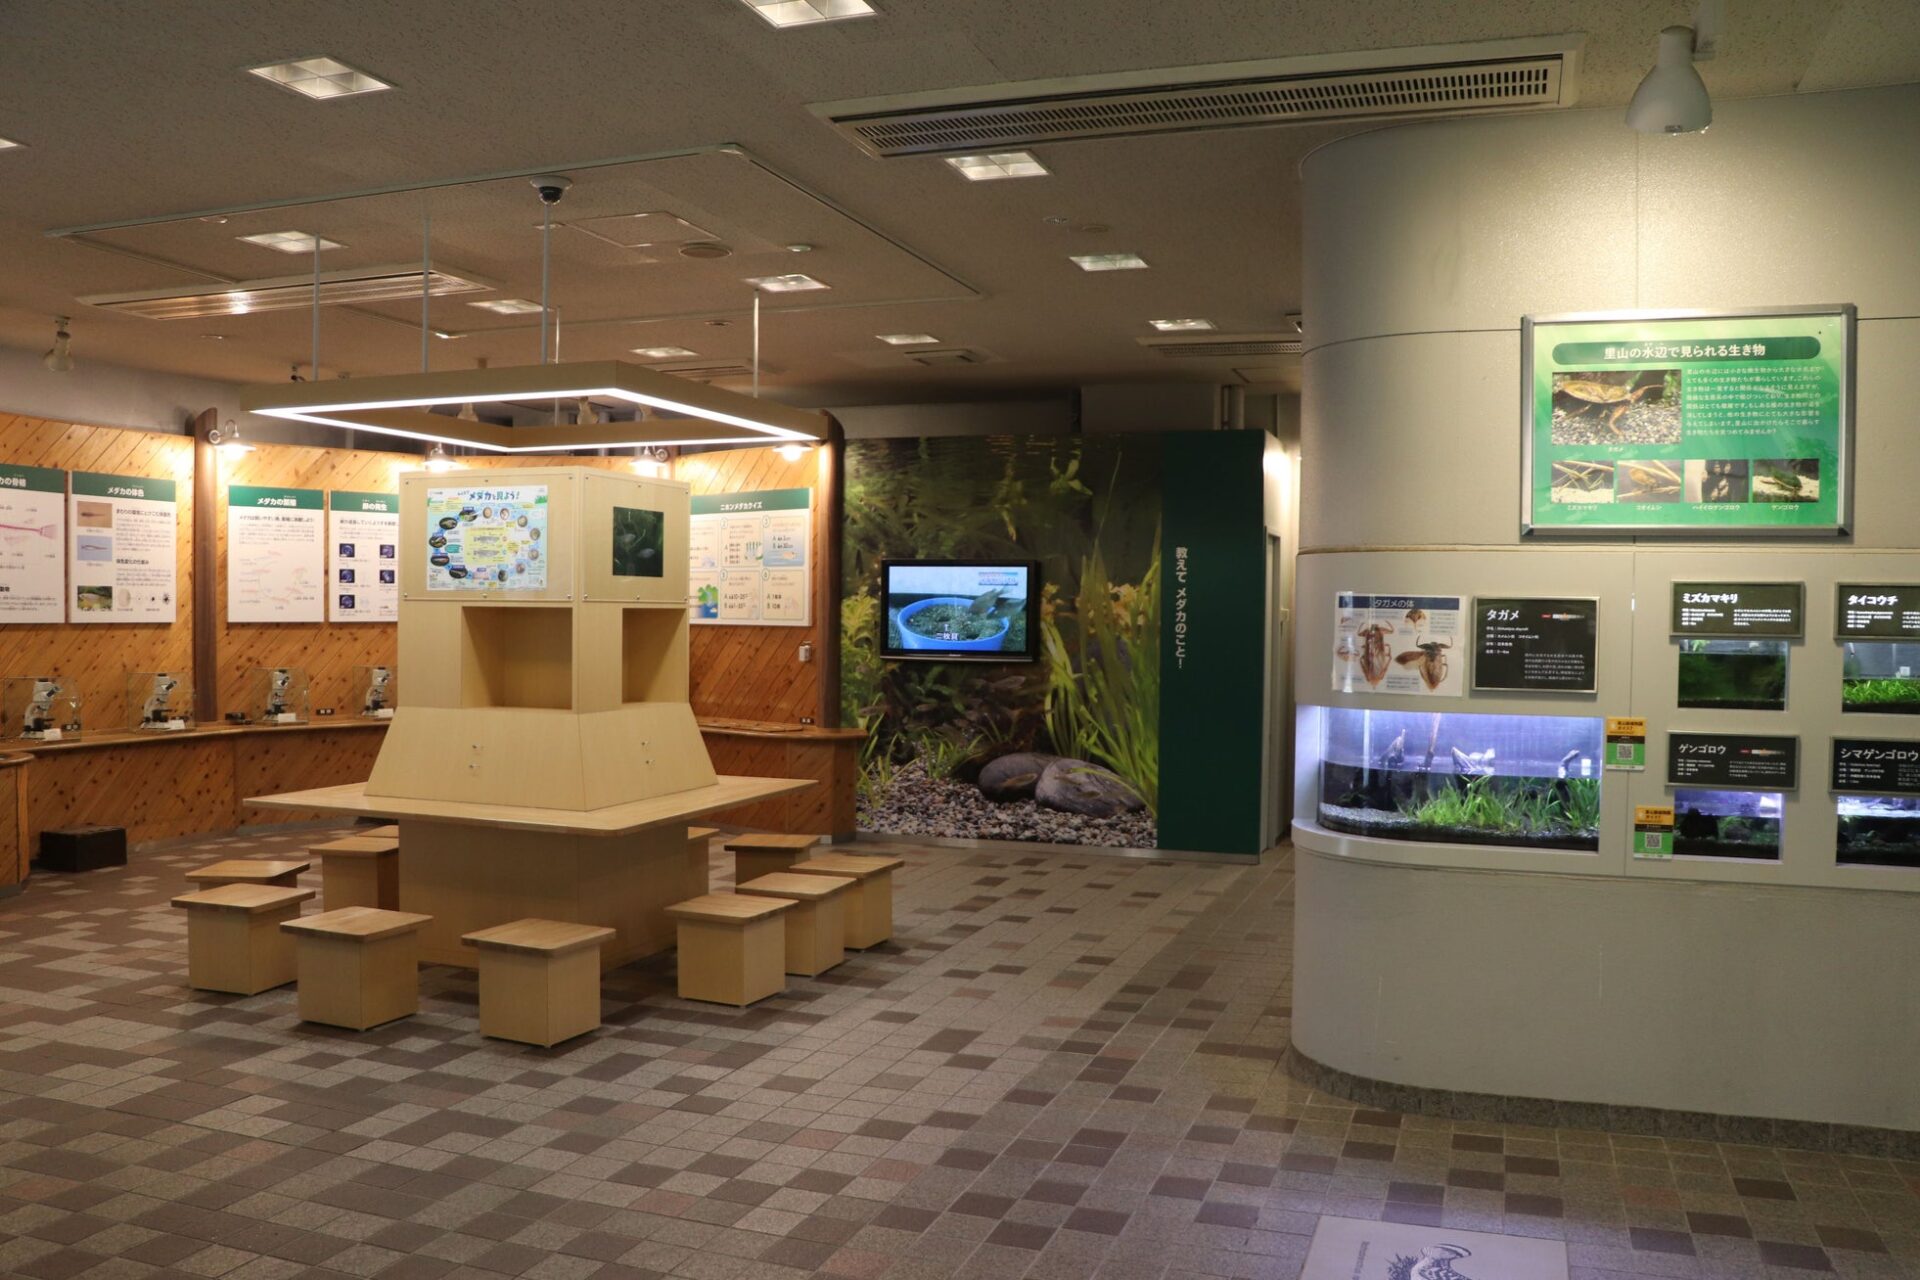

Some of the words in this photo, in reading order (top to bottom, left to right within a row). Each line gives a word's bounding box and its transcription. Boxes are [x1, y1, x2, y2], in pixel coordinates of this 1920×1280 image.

[1604, 344, 1766, 360] 里山の水辺で見られる生き物
[107, 487, 144, 497] メダカの体色
[720, 501, 762, 511] ニホンメダカクイズ
[1175, 547, 1188, 583] 教えて
[1374, 599, 1415, 608] タガメの体
[1682, 592, 1738, 604] ミズカマキリ
[1848, 594, 1899, 606] タイコウチ
[1487, 609, 1519, 621] タガメ
[1175, 588, 1187, 669] メダカのこと！
[936, 632, 958, 641] 二枚貝
[1678, 743, 1727, 754] ゲンゴロウ
[1840, 748, 1919, 761] シマゲンゴロウ
